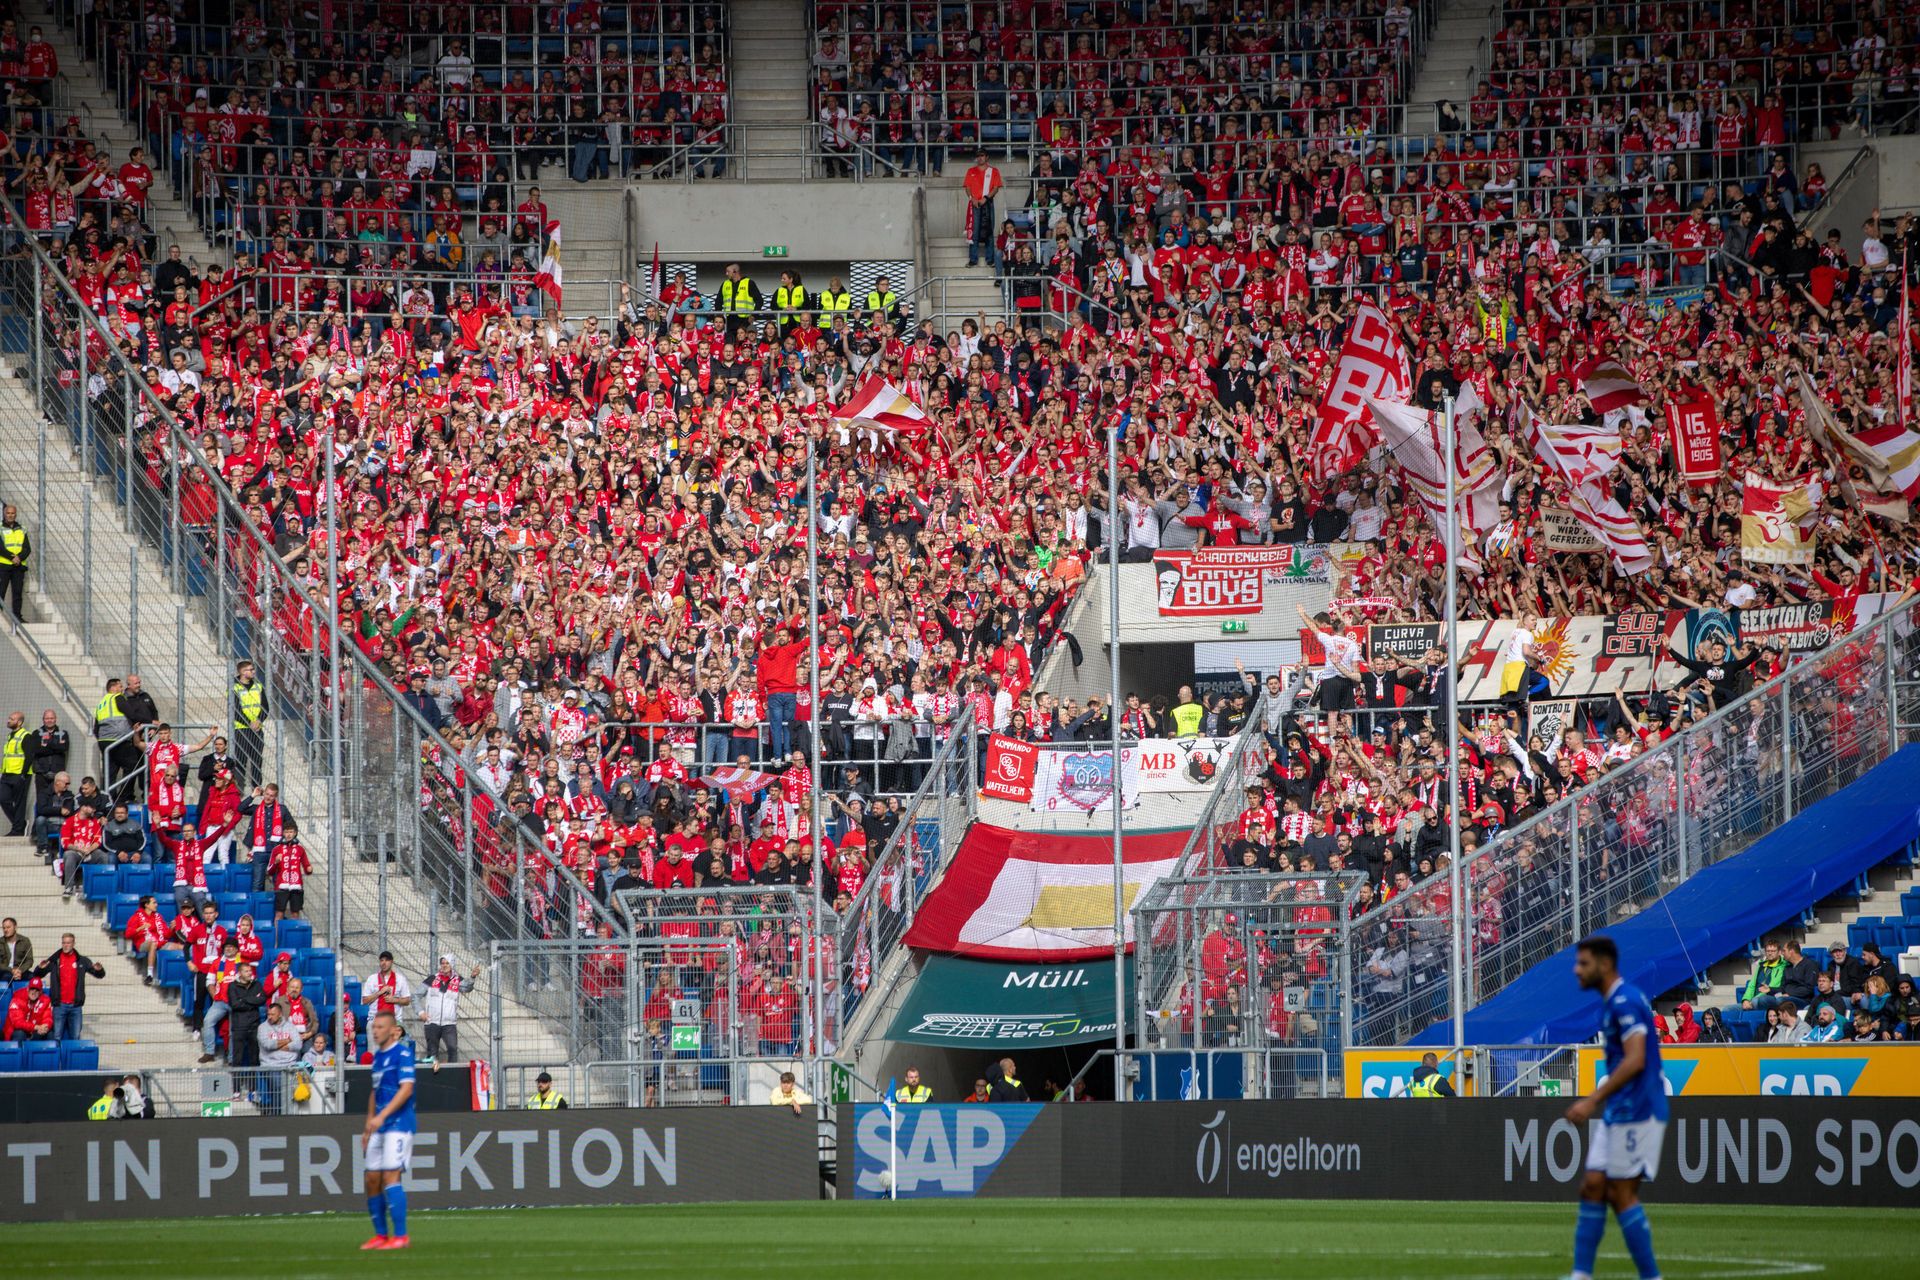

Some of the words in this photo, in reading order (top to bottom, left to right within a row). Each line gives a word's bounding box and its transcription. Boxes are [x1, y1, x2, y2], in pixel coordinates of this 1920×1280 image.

[1685, 412, 1711, 435] 16.
[1691, 449, 1714, 462] 1905
[1550, 535, 1595, 545] GEFRESSE!
[1181, 578, 1259, 605] BOYS
[1741, 605, 1808, 633] SEKTION
[1384, 627, 1425, 640] CURVA
[1374, 639, 1434, 653] PARADISO
[1533, 704, 1563, 715] CONTRO
[995, 739, 1032, 753] KOMMANDO
[1140, 752, 1176, 770] MB
[986, 781, 1026, 796] WAFFELHEIM
[1003, 968, 1089, 988] Müll.
[1288, 993, 1299, 1006] G2
[680, 1005, 694, 1017] G1
[856, 1108, 1006, 1192] SAP
[1236, 1136, 1361, 1178] engelhorn
[1677, 1118, 1792, 1184] UND
[7, 1142, 52, 1204] T
[87, 1139, 161, 1202] IN
